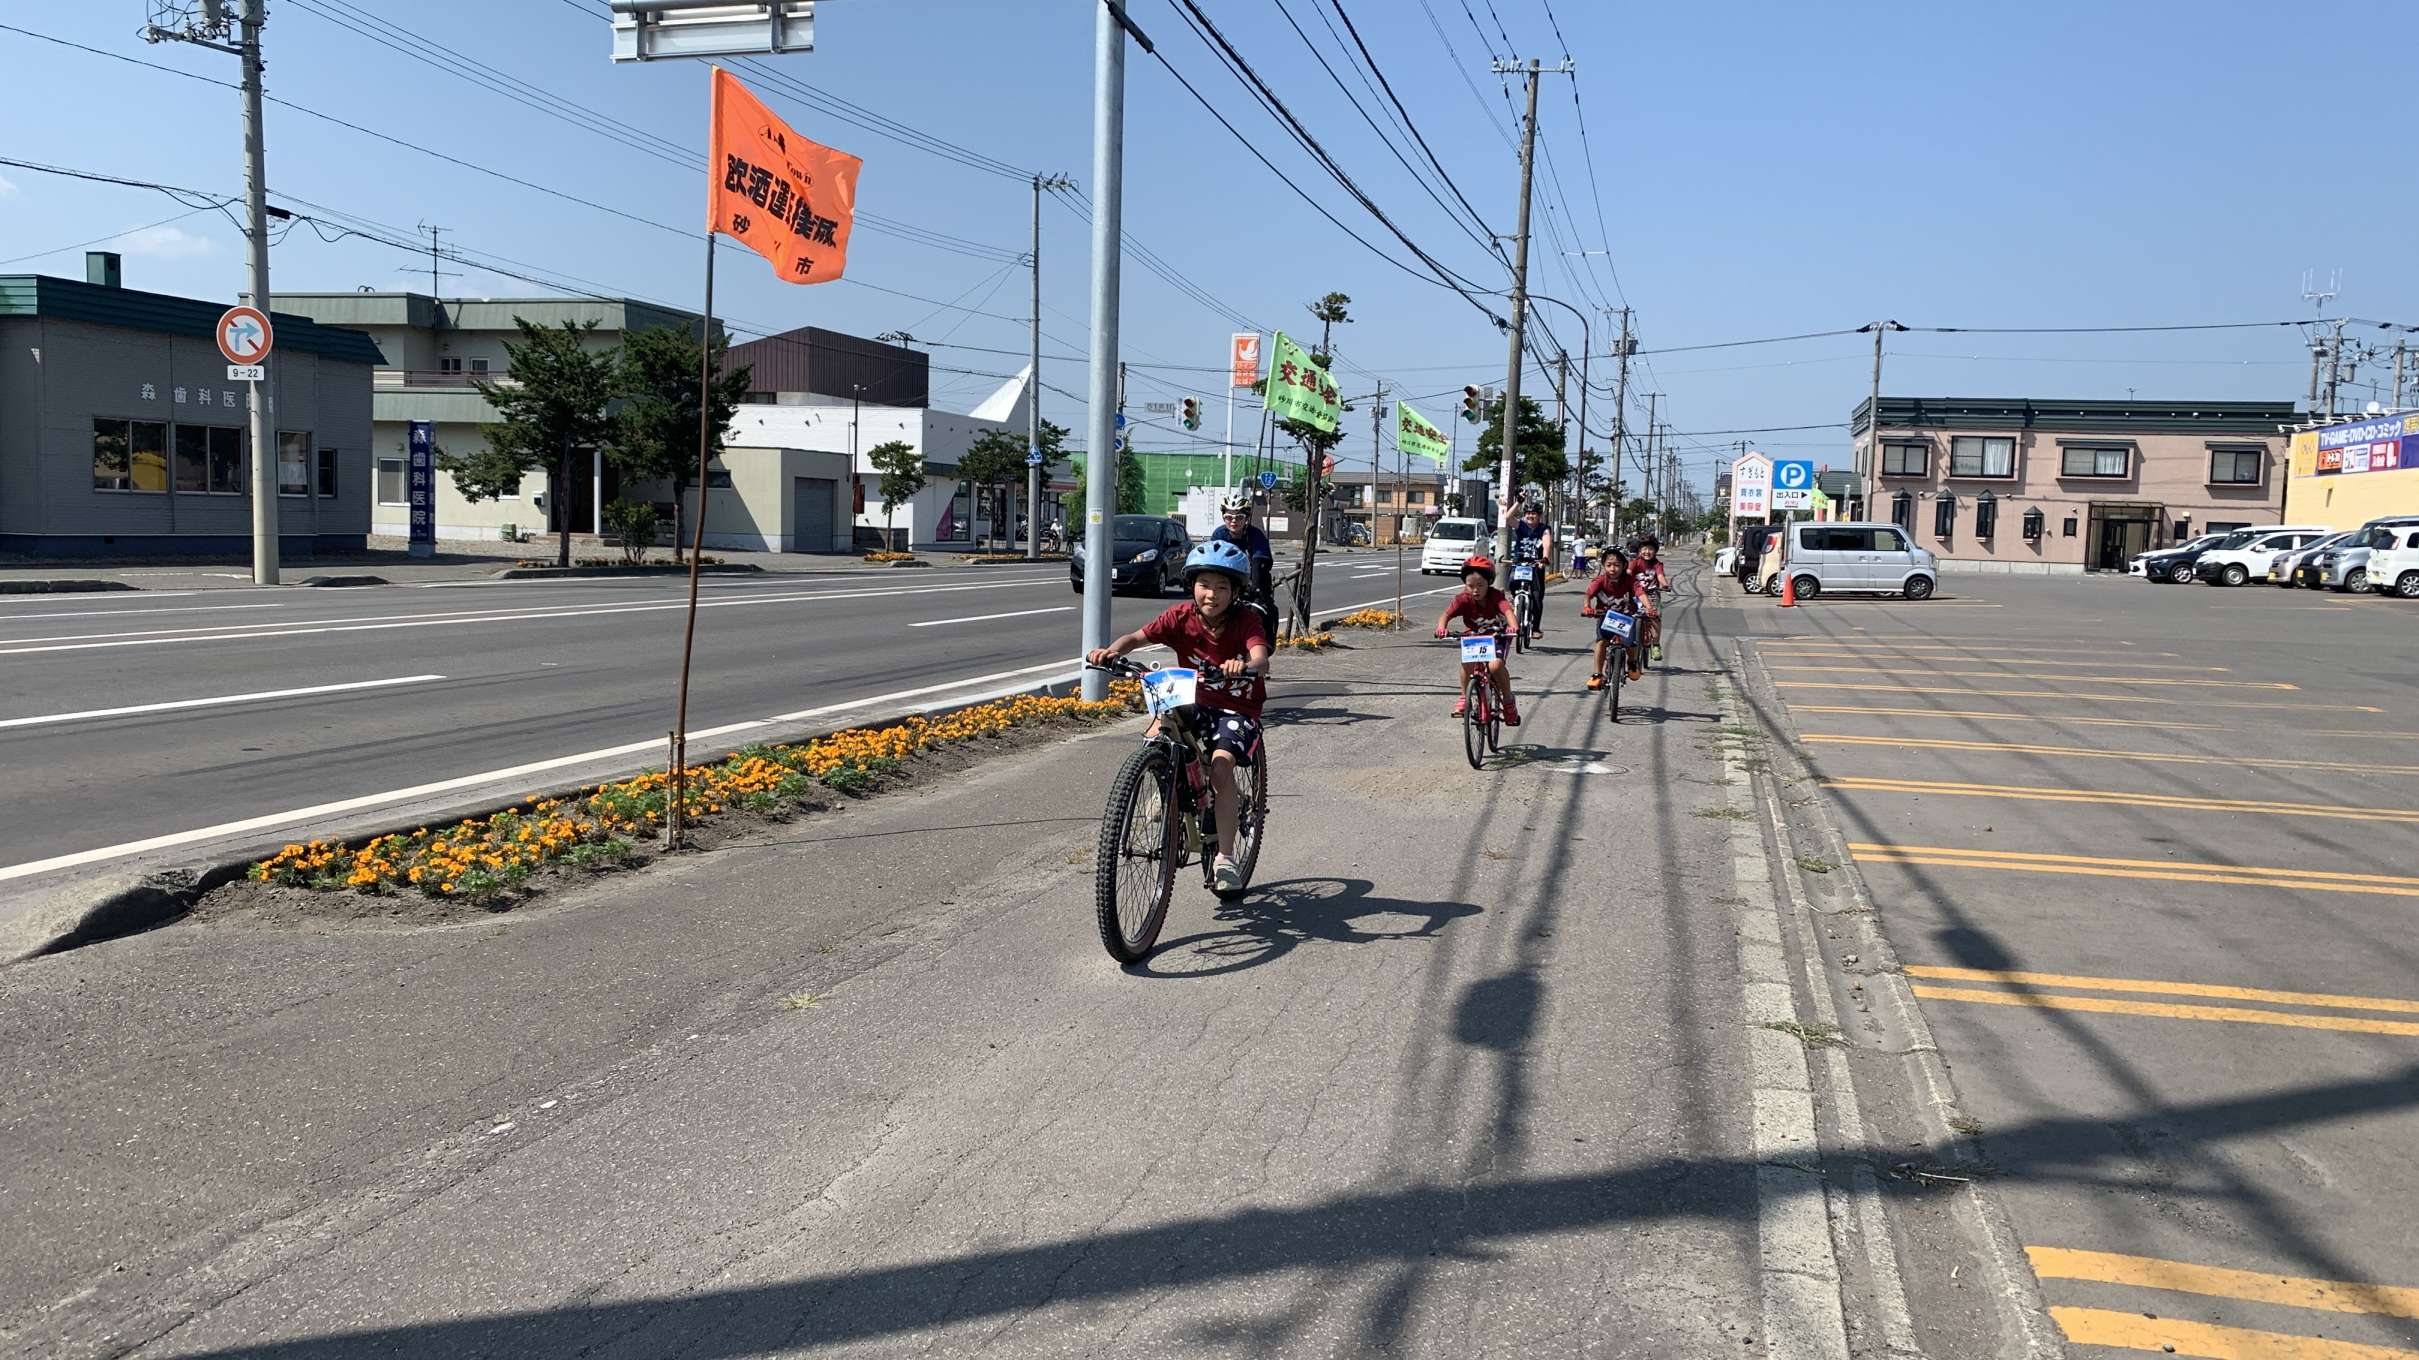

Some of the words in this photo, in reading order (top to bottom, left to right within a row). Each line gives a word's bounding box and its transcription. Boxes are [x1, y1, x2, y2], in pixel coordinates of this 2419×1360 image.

[725, 153, 839, 249] 飲酒運撲滅
[232, 368, 259, 378] 9-22
[1786, 467, 1802, 484] P
[1776, 491, 1799, 499] 出入口
